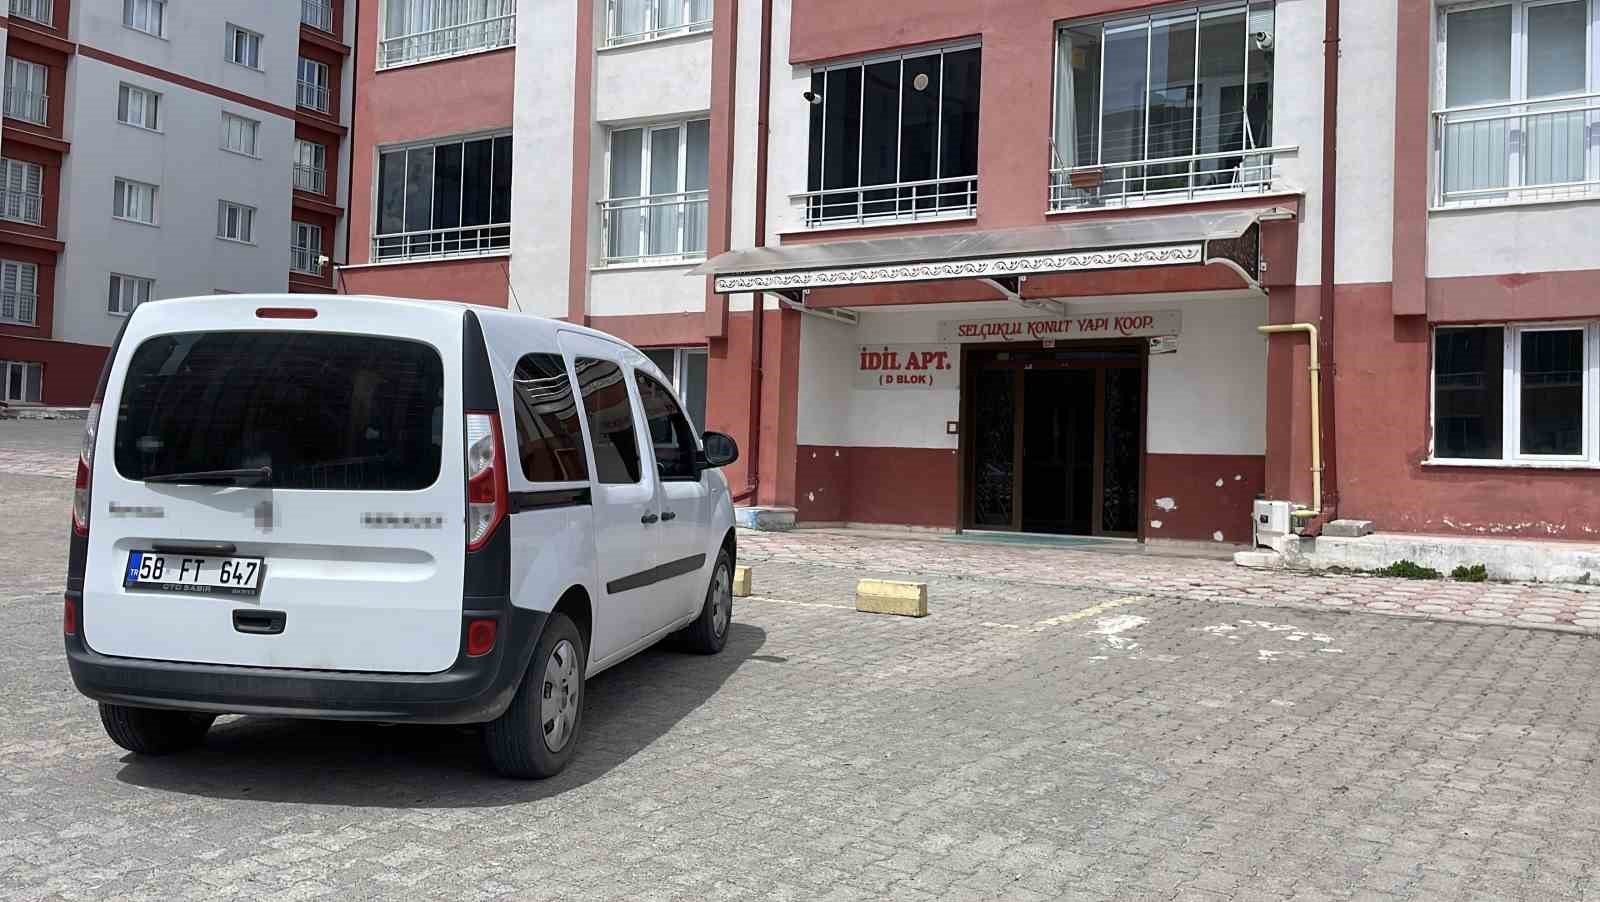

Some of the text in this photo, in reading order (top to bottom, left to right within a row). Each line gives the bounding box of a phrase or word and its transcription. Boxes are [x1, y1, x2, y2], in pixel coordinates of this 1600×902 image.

[1027, 320, 1073, 340] KONUT
[1077, 318, 1109, 332] YAPI
[1114, 315, 1154, 336] KOOP.
[859, 346, 951, 370] İDİL APT.
[129, 568, 139, 576] TR
[140, 556, 257, 585] 58 FT 647
